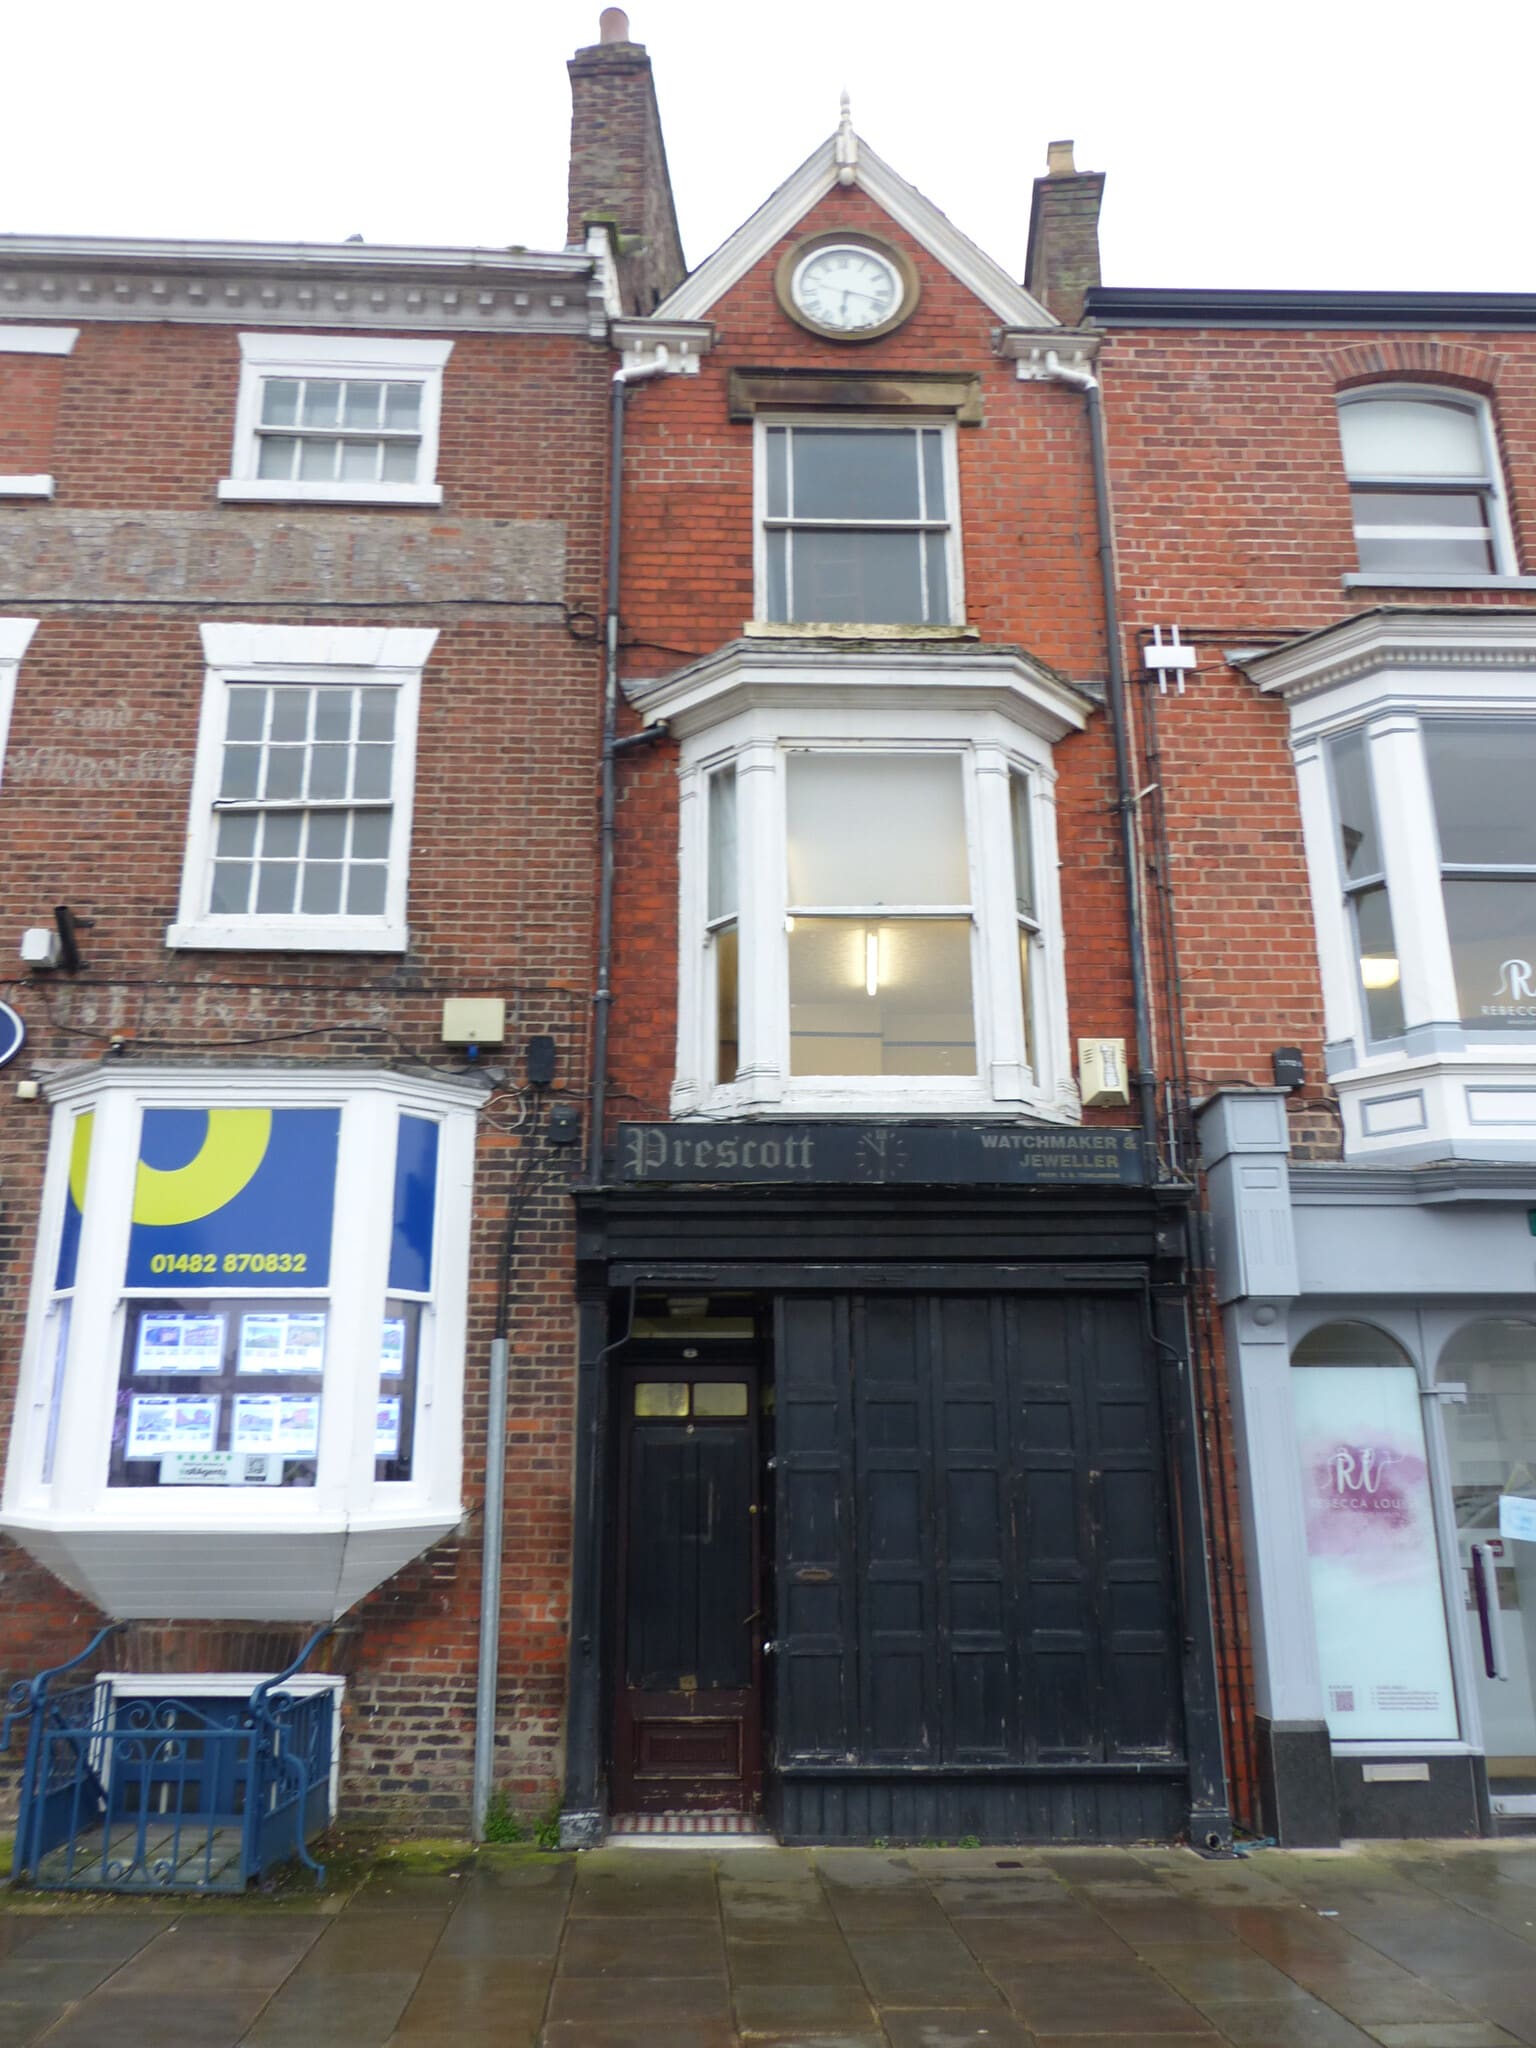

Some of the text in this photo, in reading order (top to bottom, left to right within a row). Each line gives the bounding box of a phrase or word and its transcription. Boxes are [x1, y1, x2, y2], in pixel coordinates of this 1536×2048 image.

[981, 1135, 1137, 1149] WATCHMAKER &
[623, 1128, 815, 1176] Prescott
[1020, 1154, 1119, 1168] JEWELLER
[151, 1253, 307, 1273] 01482 870832
[1311, 1498, 1368, 1510] ECCA
